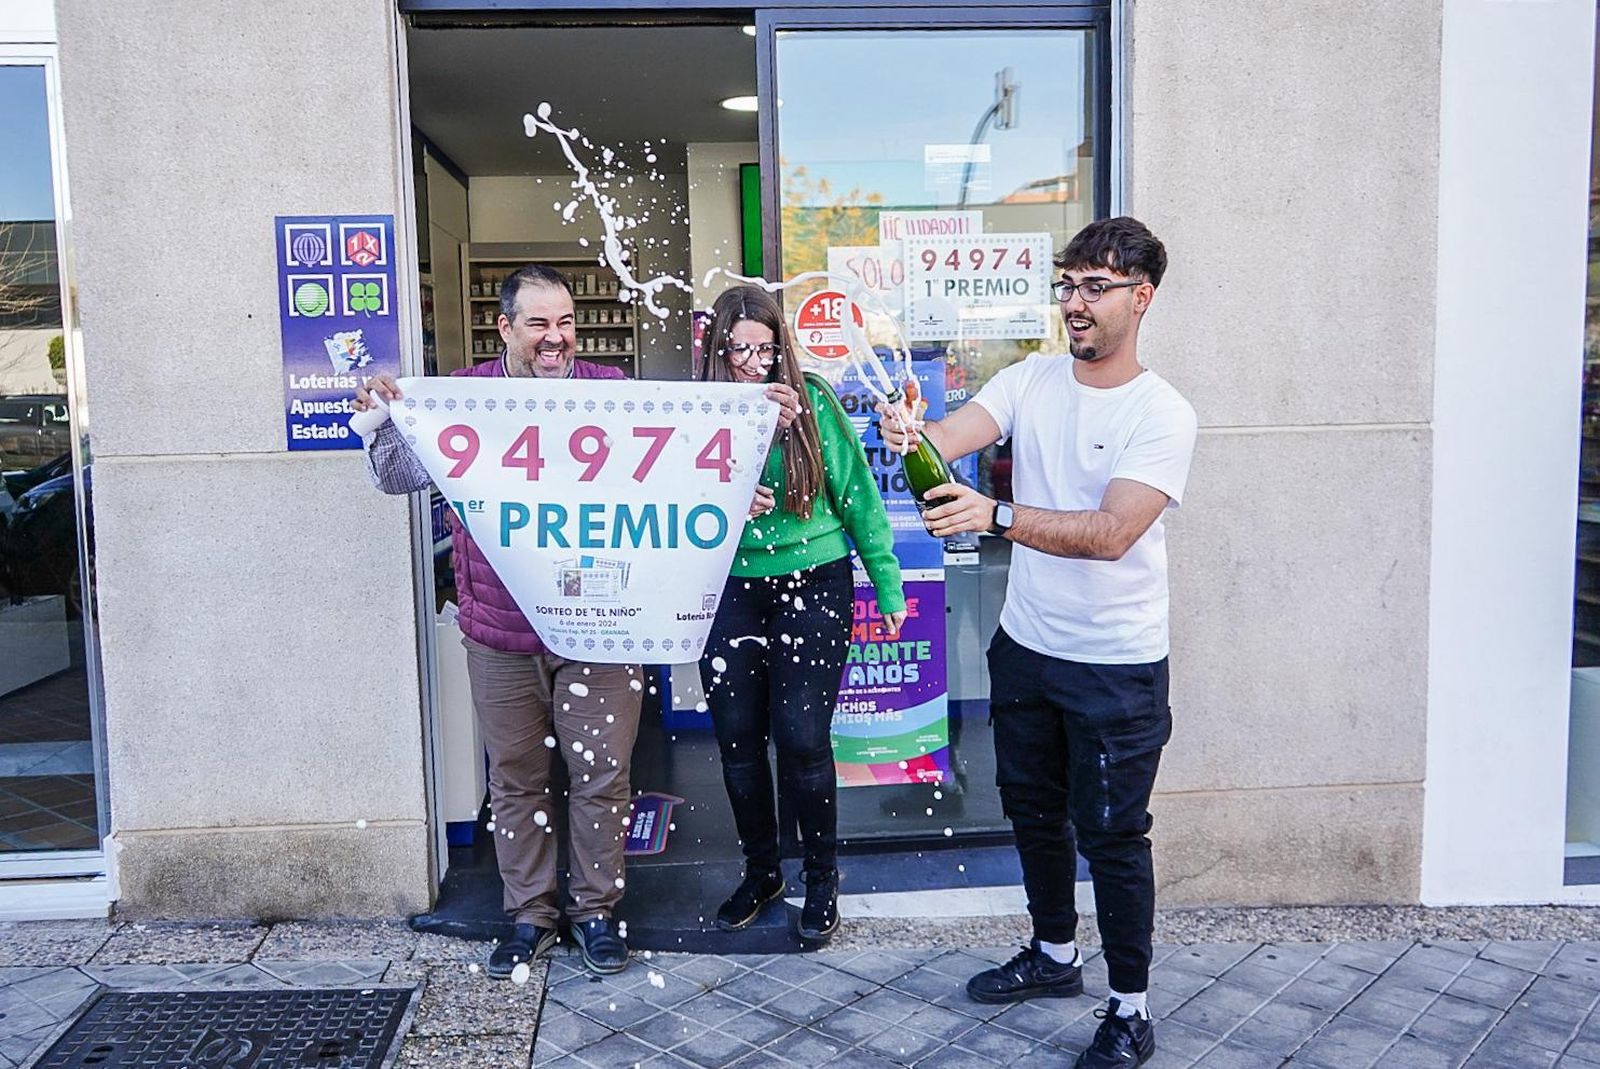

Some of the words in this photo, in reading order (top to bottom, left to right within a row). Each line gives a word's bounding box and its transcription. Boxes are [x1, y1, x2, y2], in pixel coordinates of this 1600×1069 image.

[921, 248, 1032, 271] 94974
[944, 278, 1030, 297] PREMIO
[810, 297, 845, 320] +18
[289, 374, 357, 389] Loterías
[292, 422, 349, 440] Estado
[438, 424, 737, 484] 94974
[873, 468, 909, 493] IÓ
[500, 502, 729, 549] PREMIO
[535, 606, 573, 616] SORTEO
[575, 608, 588, 617] DE
[590, 608, 607, 617] "EL
[608, 606, 642, 617] NIÑO"
[565, 619, 575, 627] de
[598, 620, 617, 628] 2024
[846, 640, 932, 664] RANTE
[848, 660, 920, 686] AÑOS
